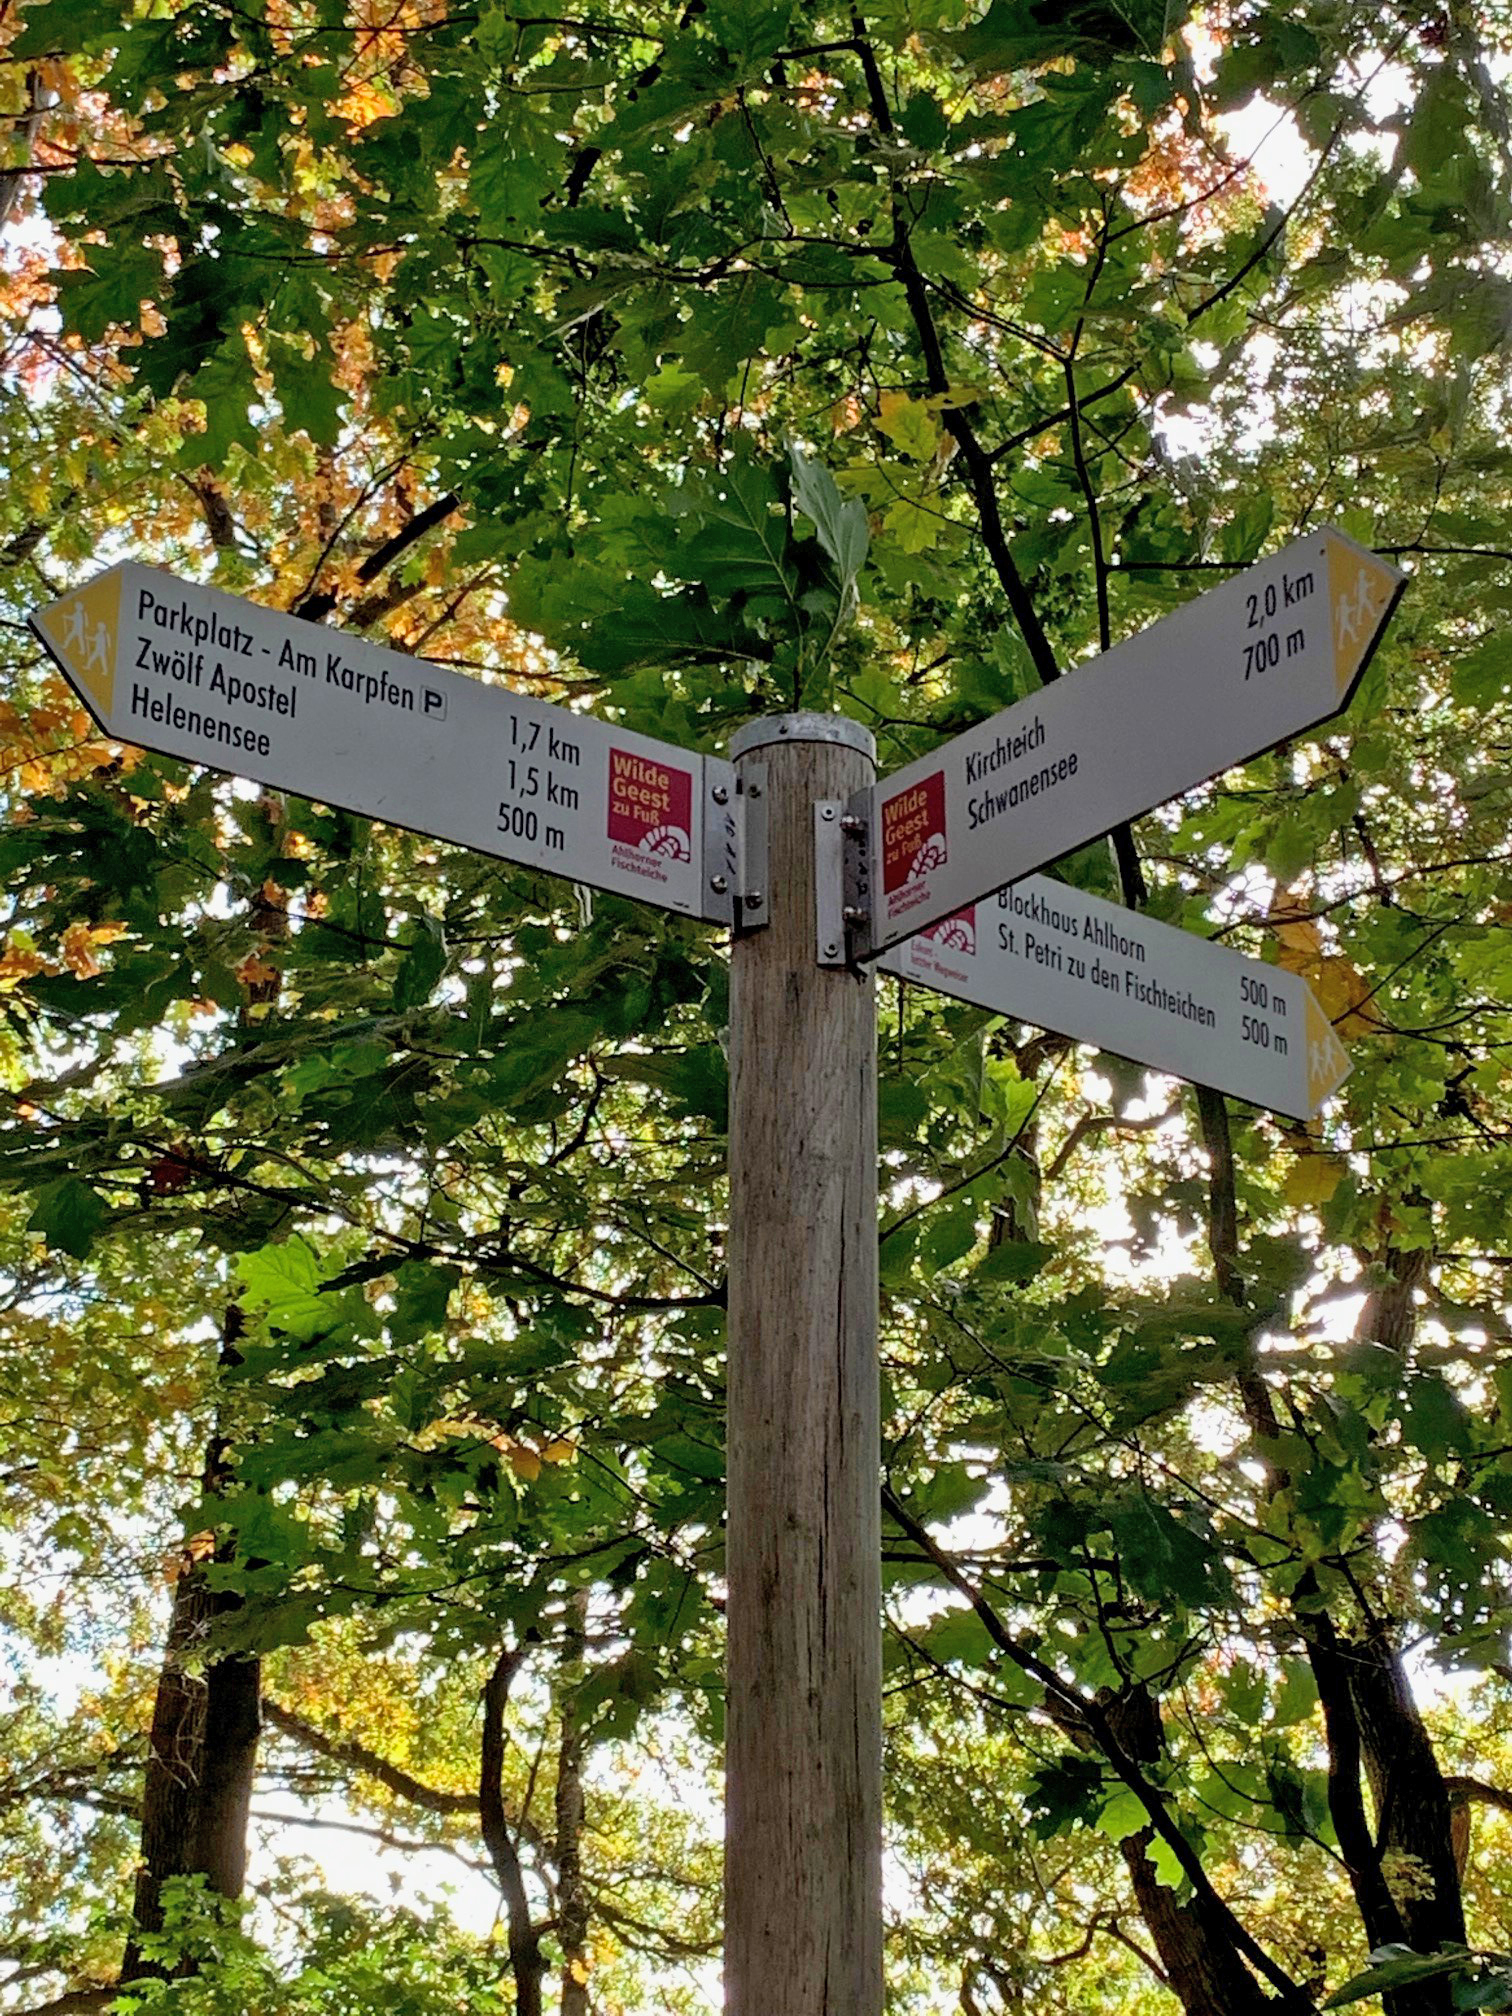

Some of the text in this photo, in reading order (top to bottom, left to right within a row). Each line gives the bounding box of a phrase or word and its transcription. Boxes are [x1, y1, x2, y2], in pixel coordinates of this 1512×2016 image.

[1247, 573, 1314, 629] 2,0 km
[138, 589, 254, 657] Parkplatz
[278, 640, 317, 678] Am
[326, 654, 414, 711] Karpfen
[1243, 629, 1305, 680] 700 m
[135, 636, 297, 718] Zwölf Apostel
[131, 683, 270, 757] Helenensee
[510, 715, 580, 766] 1,7 km
[612, 754, 670, 790] Wilde
[965, 715, 1045, 785] Kirchteich
[508, 759, 579, 810] 1,5 km
[612, 777, 671, 812] Geest
[884, 790, 927, 826] Wilde
[968, 753, 1078, 830] Schwanensee
[497, 802, 564, 850] 500 m
[612, 801, 661, 827] zu Fuß
[885, 808, 929, 846] Geest
[998, 887, 1146, 963] Blockhaus Ahlhorn
[999, 924, 1216, 1029] St. Petri zu den Fischteichen
[1240, 975, 1287, 1017] 500 m
[1241, 1015, 1288, 1056] 500 m
